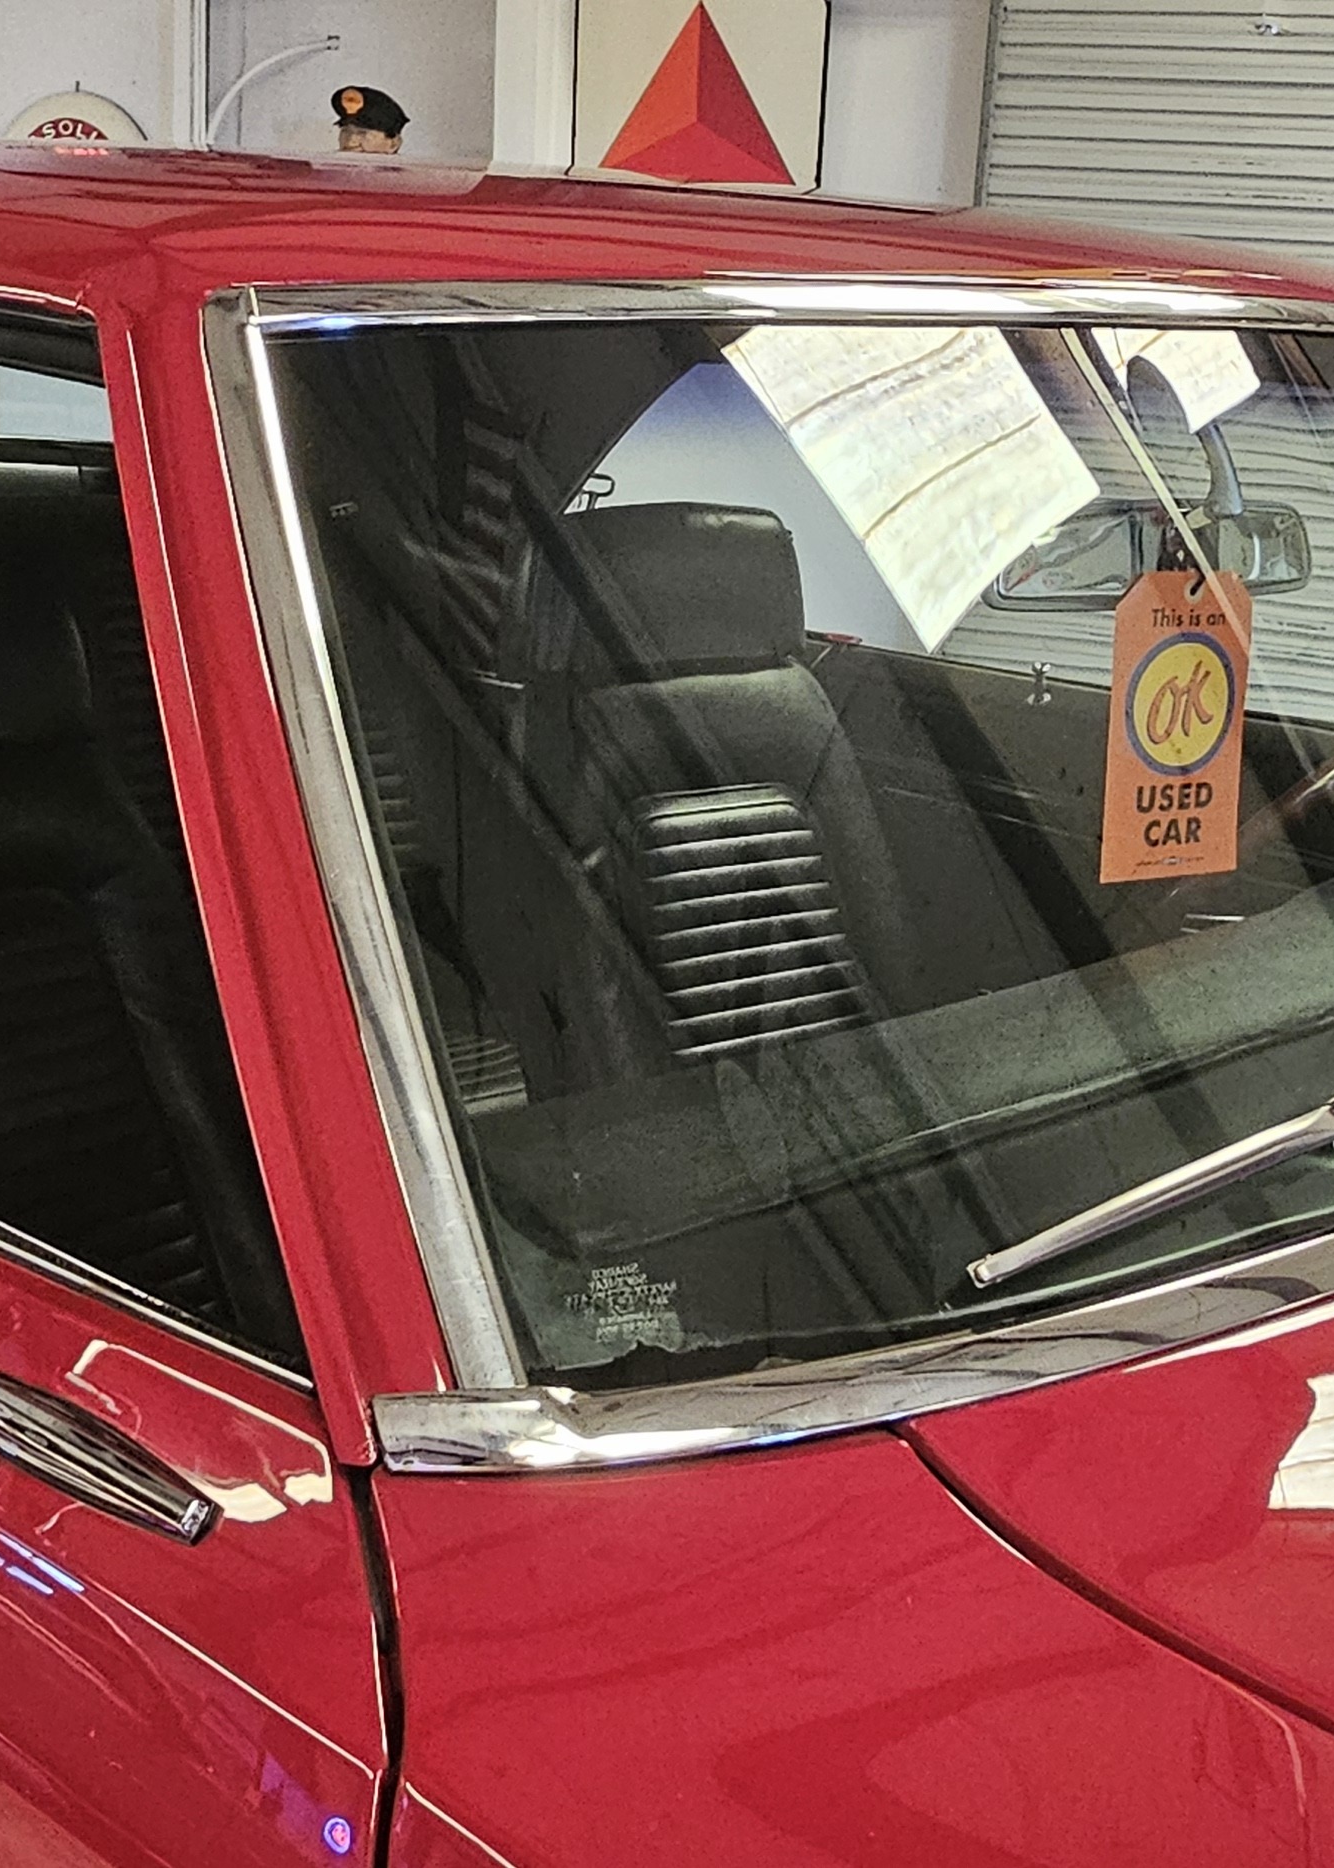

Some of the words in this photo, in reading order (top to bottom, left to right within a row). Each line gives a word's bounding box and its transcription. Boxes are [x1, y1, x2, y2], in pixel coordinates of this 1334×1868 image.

[1152, 608, 1184, 627] This
[1188, 609, 1203, 627] is
[1146, 660, 1215, 745] OK
[1136, 782, 1214, 814] USED
[1144, 816, 1202, 848] CAR
